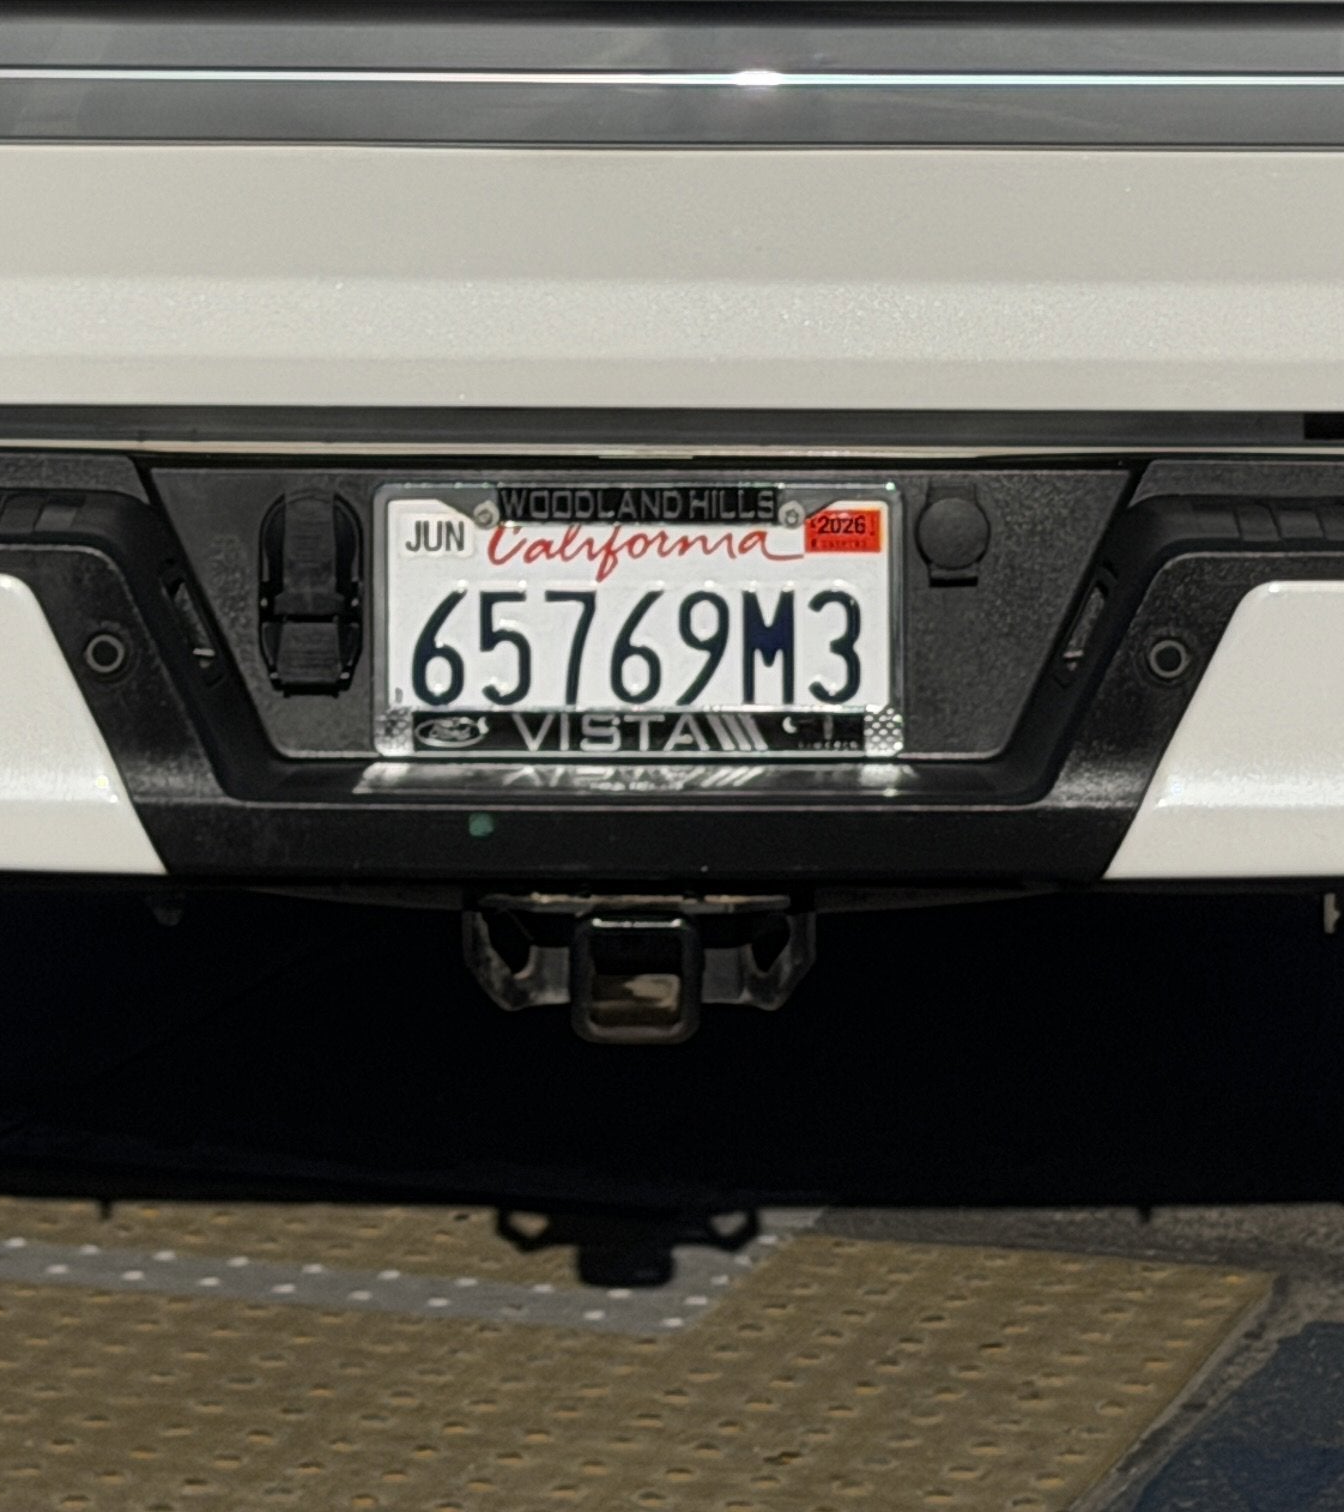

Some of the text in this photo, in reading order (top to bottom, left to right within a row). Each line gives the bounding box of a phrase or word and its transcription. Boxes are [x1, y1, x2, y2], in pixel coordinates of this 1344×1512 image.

[501, 489, 774, 519] WOODLAND HILLS
[405, 521, 466, 552] JUN
[487, 524, 804, 582] California
[411, 590, 862, 705] 65769M3
[513, 714, 710, 751] VISTA
